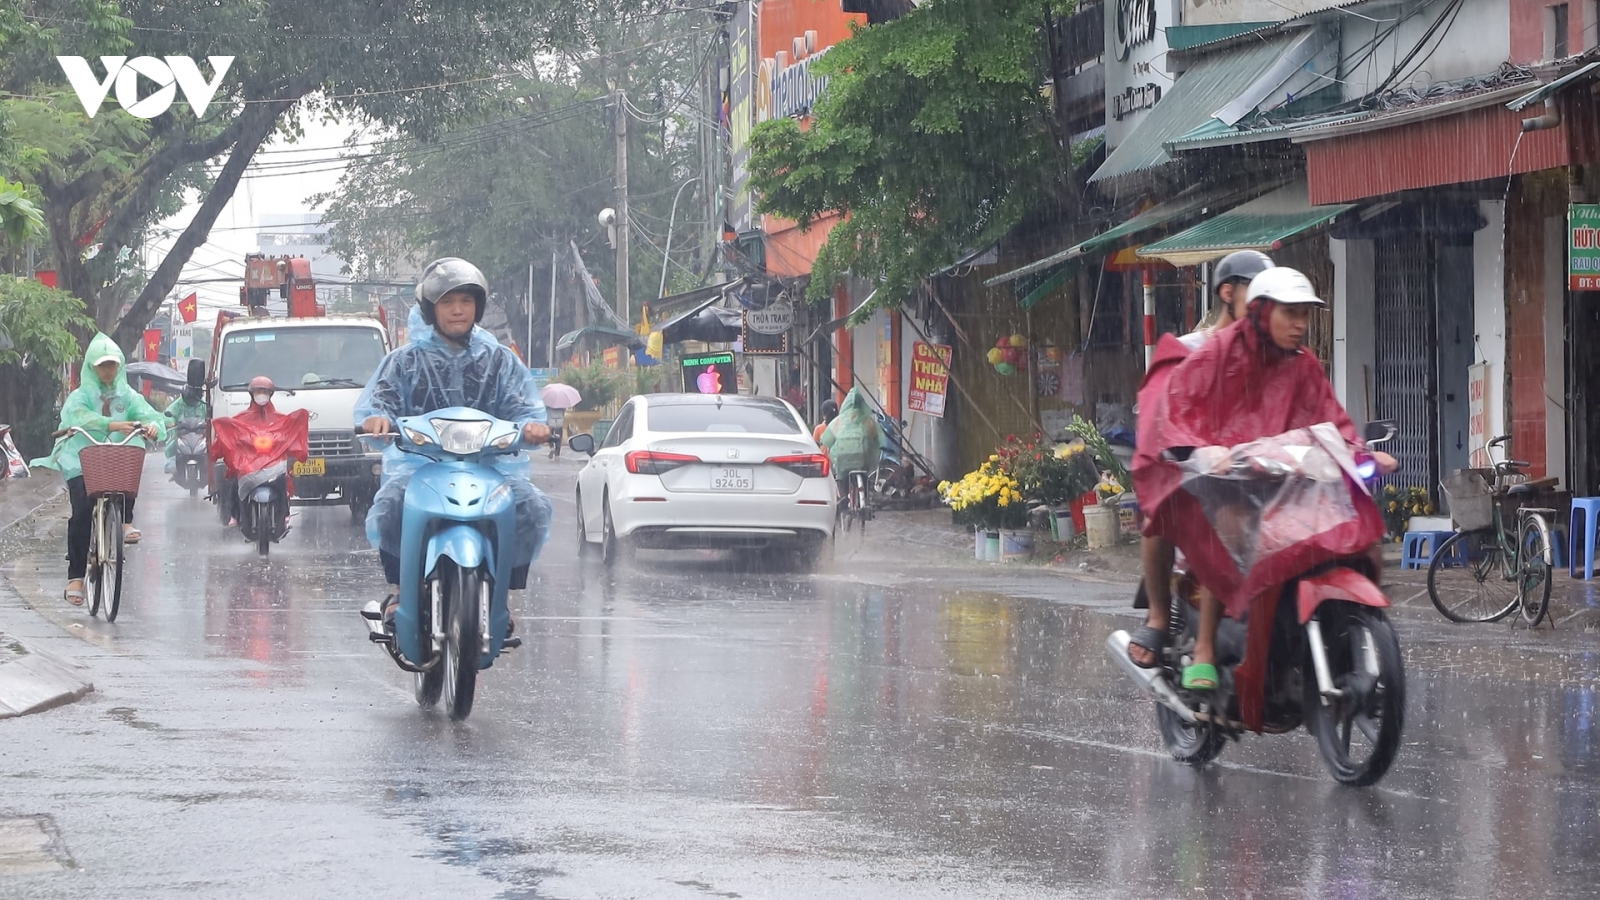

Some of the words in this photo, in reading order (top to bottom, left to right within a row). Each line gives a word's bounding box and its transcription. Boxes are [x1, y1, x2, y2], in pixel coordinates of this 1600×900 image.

[1573, 225, 1595, 249] HÚT
[1573, 257, 1590, 270] RAU
[770, 313, 790, 324] TRANG
[700, 355, 732, 365] COMPUTER
[915, 377, 944, 394] NHÀ
[723, 469, 741, 479] 30L
[715, 479, 749, 488] 924.05
